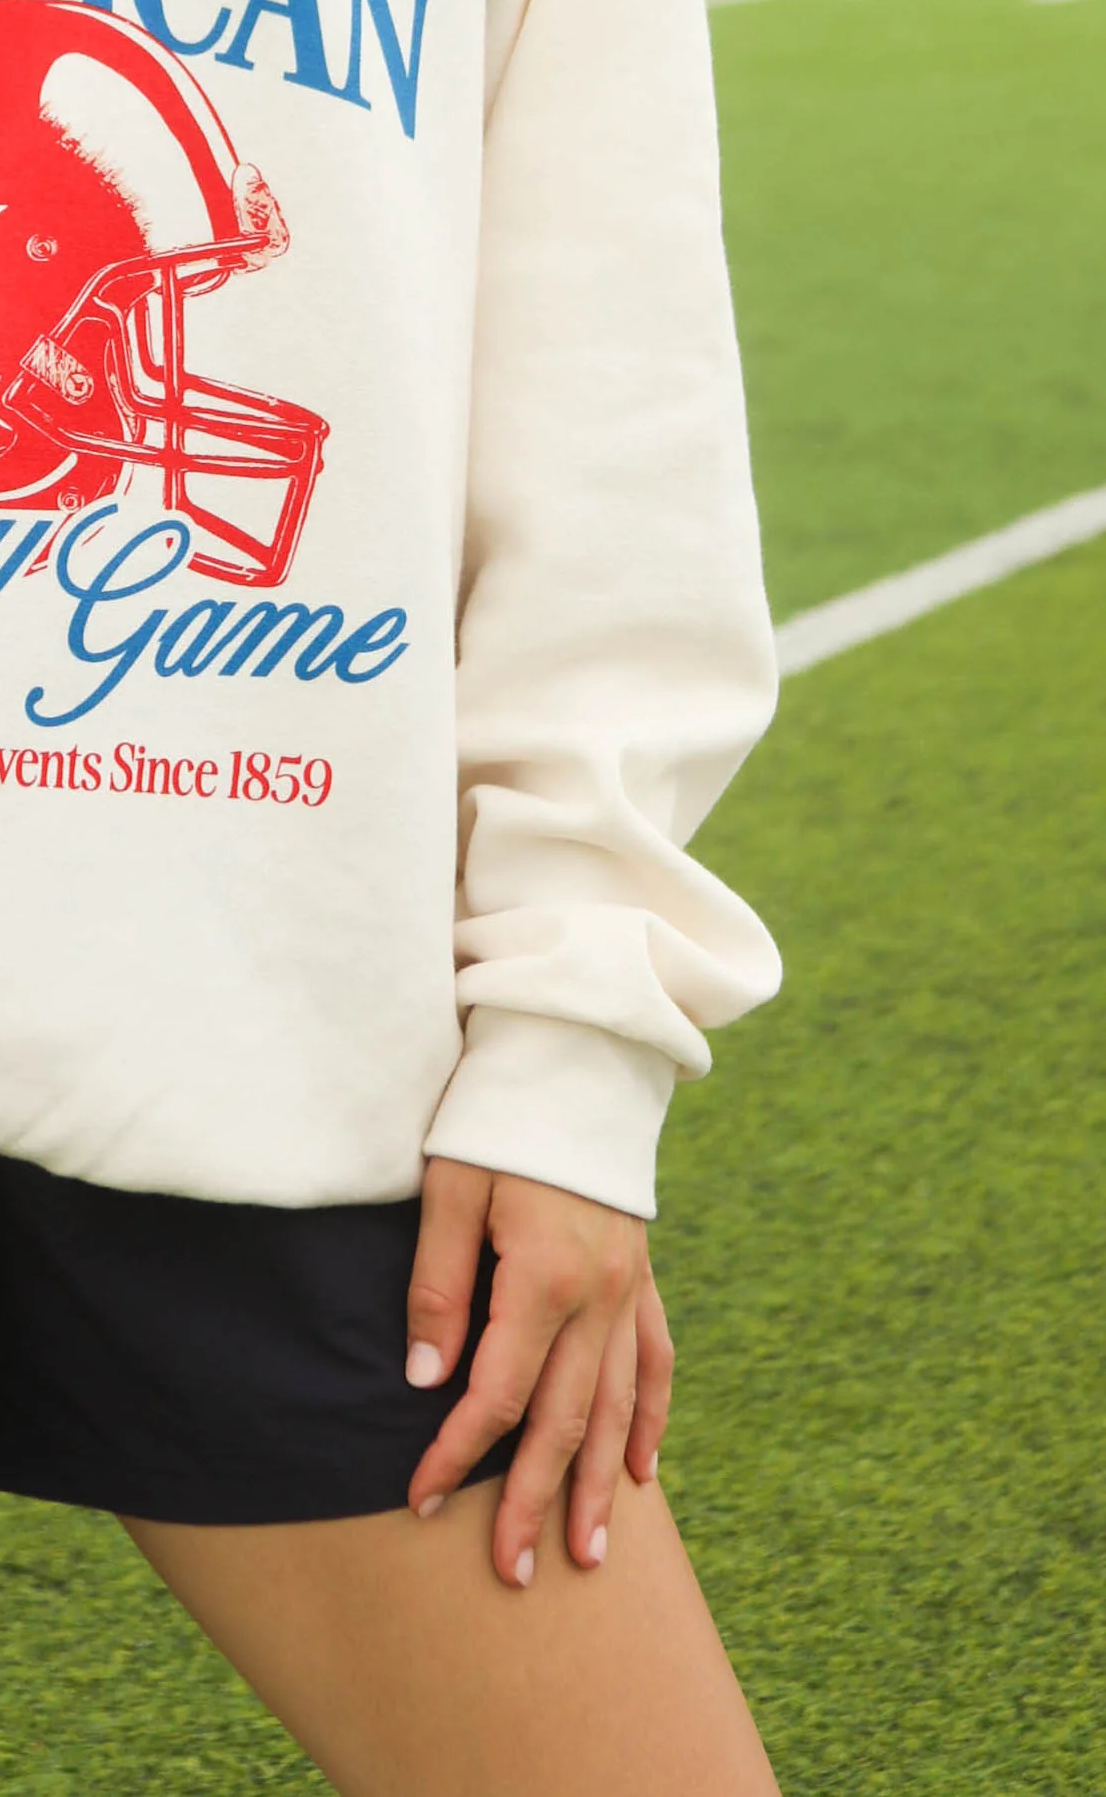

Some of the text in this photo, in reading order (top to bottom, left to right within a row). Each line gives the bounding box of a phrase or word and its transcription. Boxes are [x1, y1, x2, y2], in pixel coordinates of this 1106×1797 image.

[24, 503, 409, 729] Game
[109, 742, 220, 800] Since
[227, 750, 334, 808] 1859
